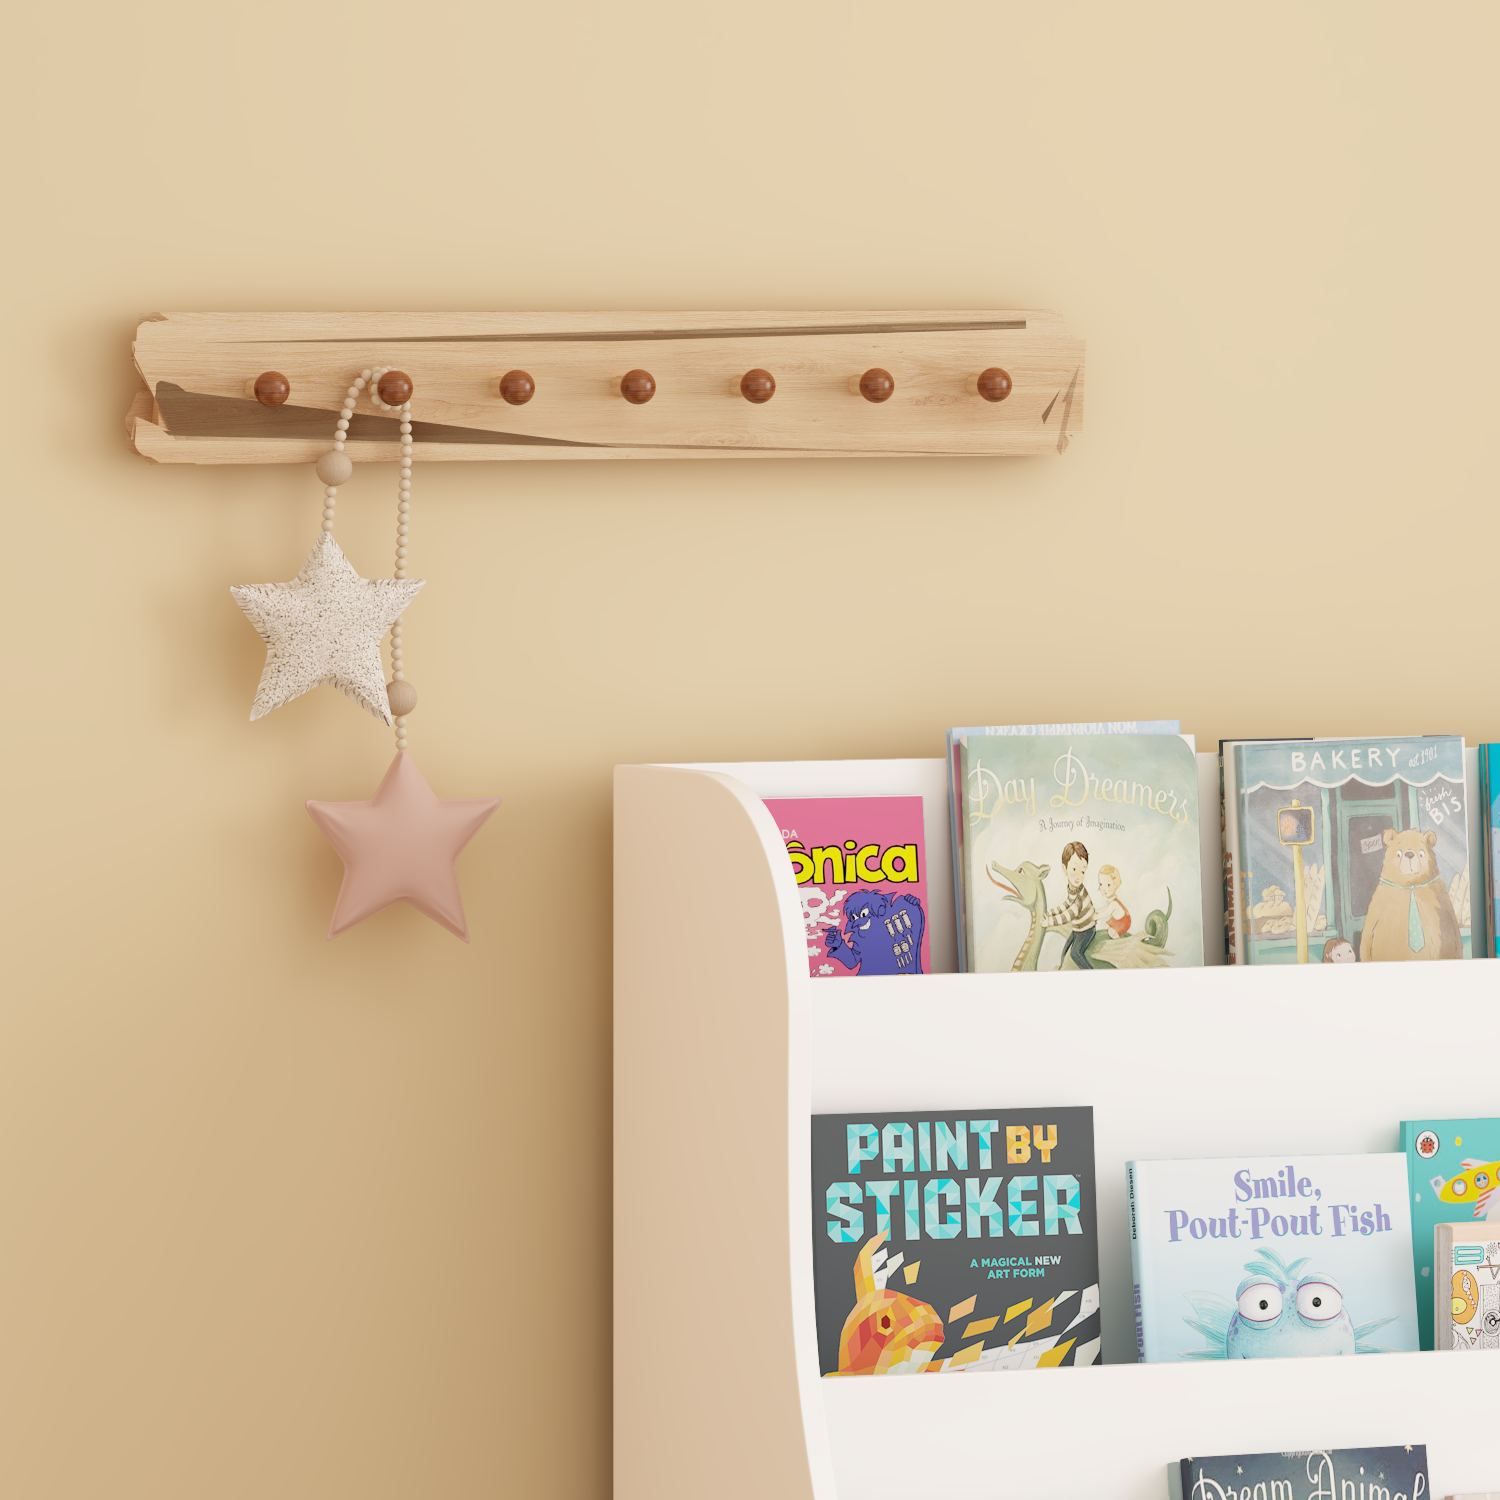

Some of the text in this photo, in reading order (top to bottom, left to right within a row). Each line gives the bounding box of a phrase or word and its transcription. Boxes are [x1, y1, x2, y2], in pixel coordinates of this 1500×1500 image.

[1291, 747, 1401, 772] BAKERY
[1420, 744, 1438, 765] 1901
[968, 746, 1189, 826] Day Dreamers
[1425, 787, 1452, 811] fresh
[1039, 816, 1126, 832] A Journey of Imagination
[846, 1119, 1057, 1174] PAINT BY
[1234, 1165, 1322, 1204] Smile,
[825, 1174, 1084, 1244] STICKER
[1164, 1203, 1393, 1243] Pout-Pout Fish
[970, 1255, 1062, 1268] A MAGICAL NEW
[987, 1267, 1045, 1279] ART FORM
